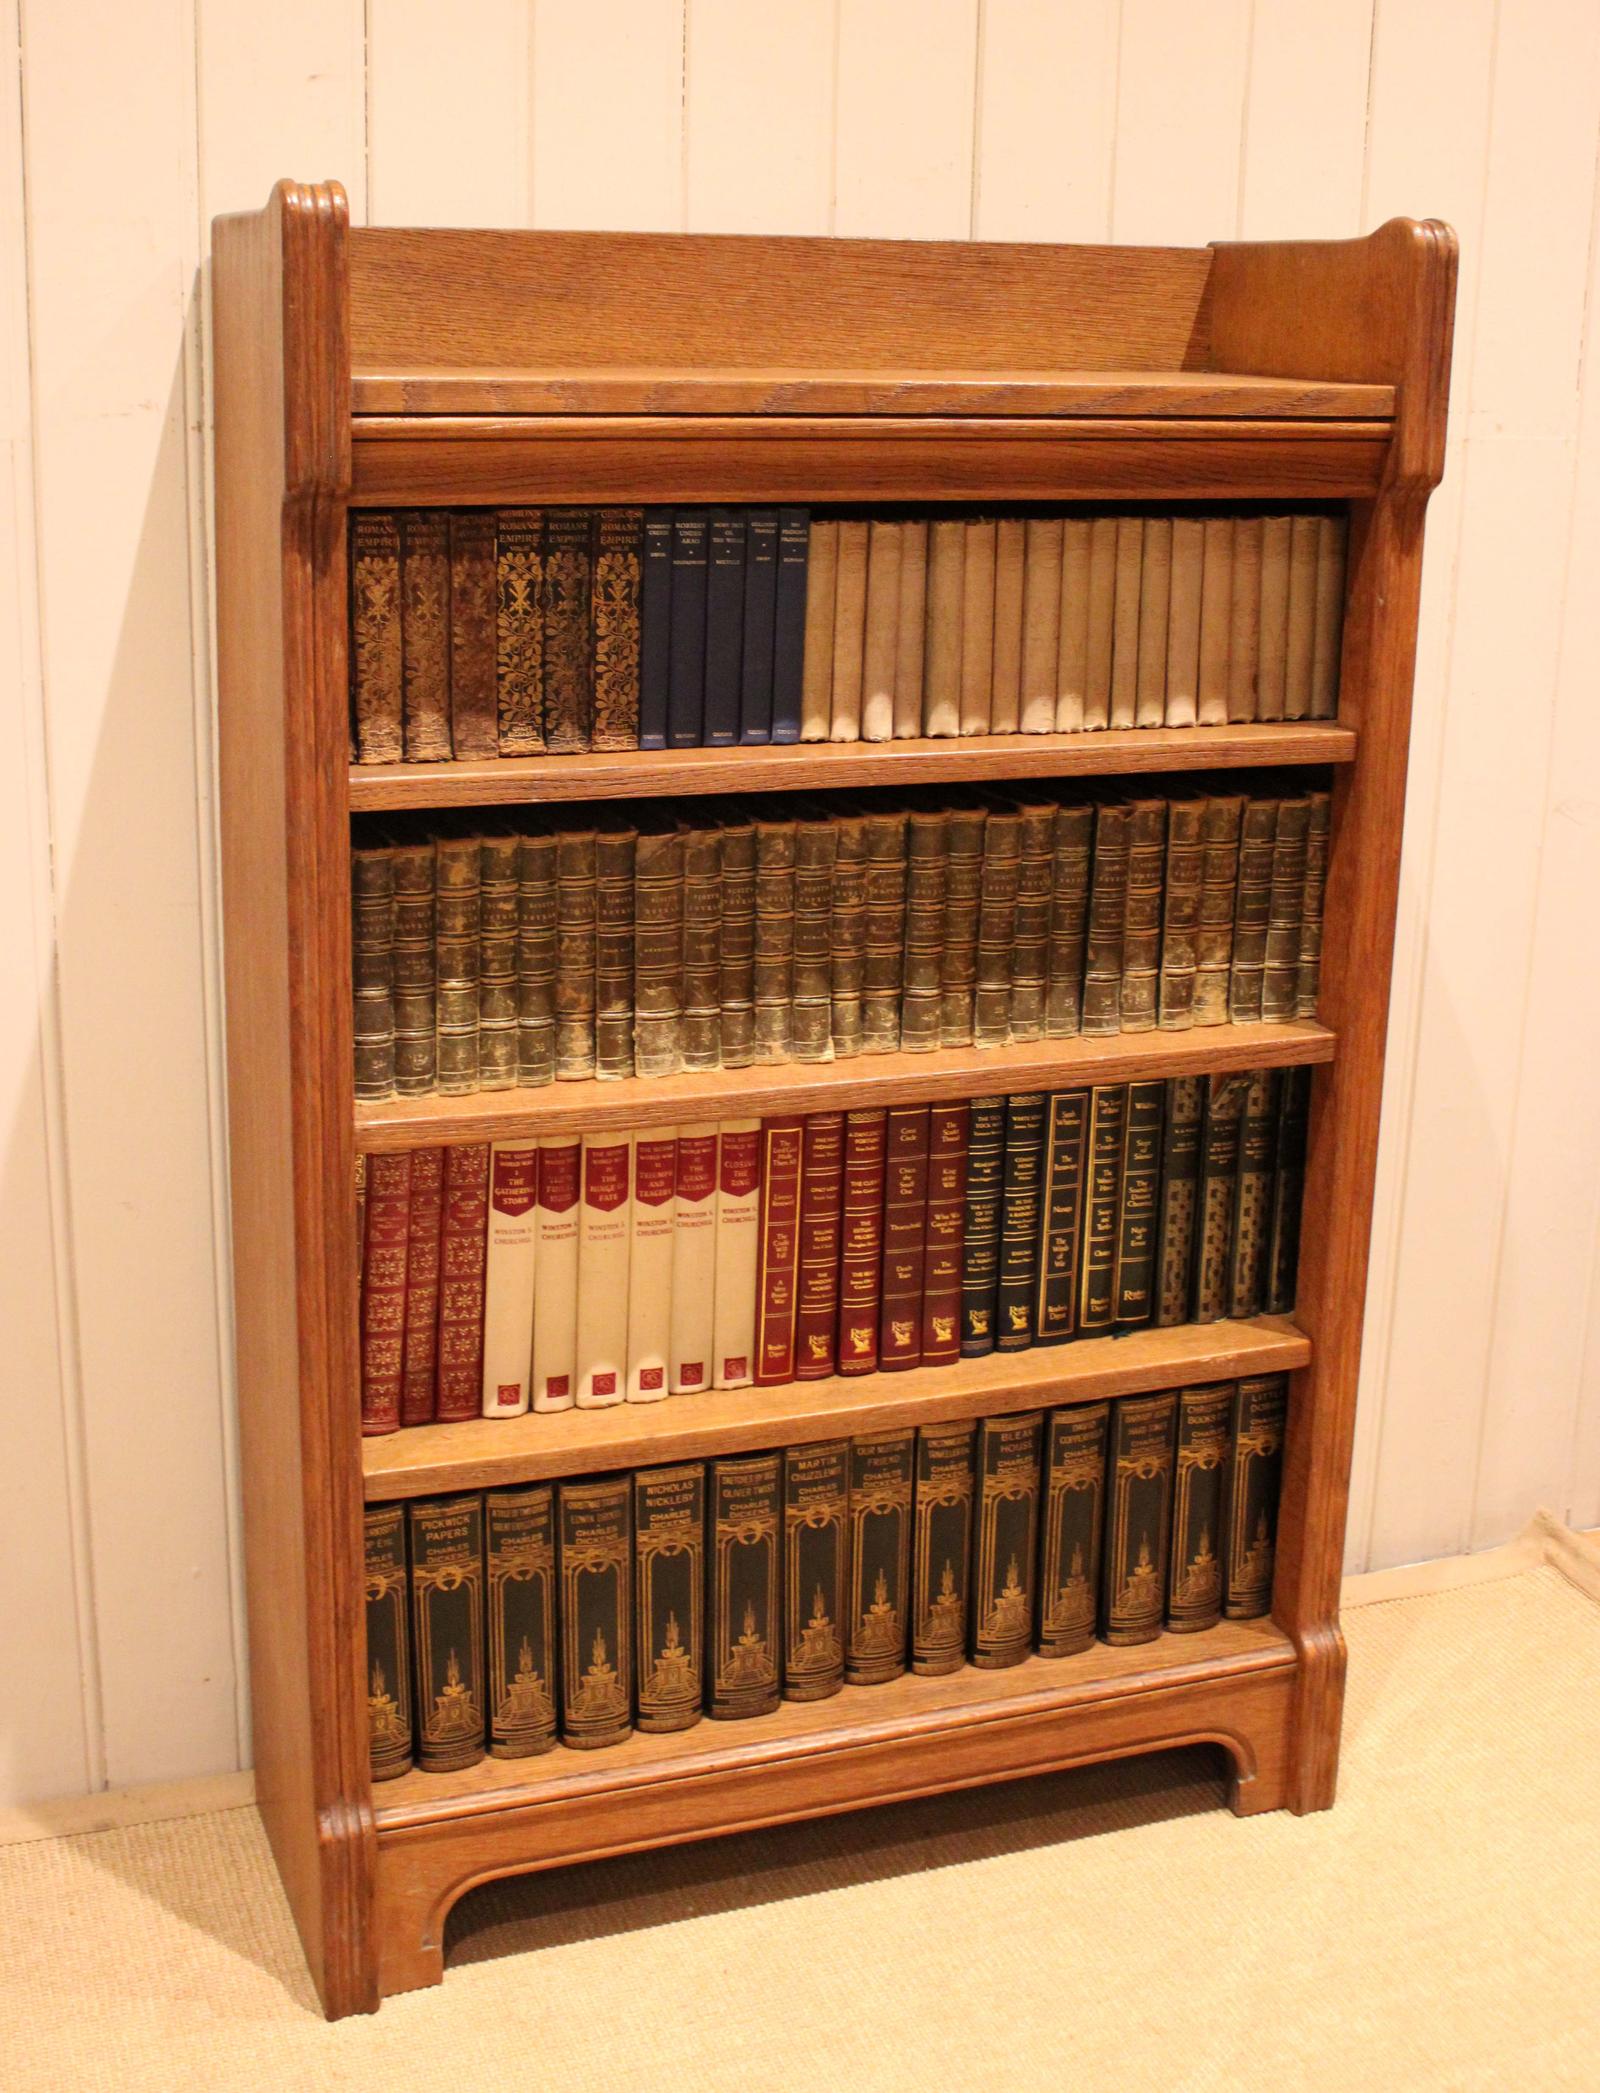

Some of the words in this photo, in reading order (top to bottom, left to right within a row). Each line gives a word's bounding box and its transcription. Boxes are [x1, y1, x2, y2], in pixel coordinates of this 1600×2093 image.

[499, 534, 541, 544] EMPIRE
[548, 534, 588, 544] EMPIRE
[600, 535, 639, 545] EMPIRE
[689, 1164, 704, 1172] THE
[734, 1170, 749, 1178] THE
[507, 1178, 525, 1186] THE
[601, 1175, 617, 1183] THE
[648, 1180, 665, 1188] AND
[598, 1193, 618, 1201] FATE
[639, 1188, 672, 1197] TRAGEDY
[503, 1197, 529, 1205] STORM
[676, 1219, 713, 1227] CHURCHILL
[722, 1216, 757, 1224] CHURCHILL
[588, 1223, 619, 1231] WINSTON
[636, 1228, 673, 1236] CHURCHILL
[542, 1231, 577, 1240] CHURCHILL
[856, 1446, 875, 1456] OUR
[1000, 1440, 1033, 1453] HOUSE
[1064, 1445, 1098, 1458] CHARLES
[798, 1456, 837, 1470] MARTIN
[931, 1461, 968, 1473] CHARLES
[997, 1455, 1033, 1467] CHARLES
[863, 1469, 902, 1481] CHARLES
[646, 1480, 694, 1495] NICHOLAS
[722, 1487, 752, 1498] OLIVER
[753, 1482, 776, 1494] TWIST
[798, 1482, 838, 1496] CHARLES
[646, 1492, 695, 1507] NICKLEBY
[729, 1499, 770, 1511] CHARLES
[650, 1509, 691, 1521] CHARLES
[729, 1507, 770, 1519] DICKENS
[421, 1513, 470, 1530] PICKWICK
[650, 1517, 691, 1530] DICKENS
[425, 1526, 469, 1541] PAPERS
[576, 1525, 618, 1538] CHARLES
[501, 1532, 543, 1546] CHARLES
[426, 1542, 470, 1556] CHARLES
